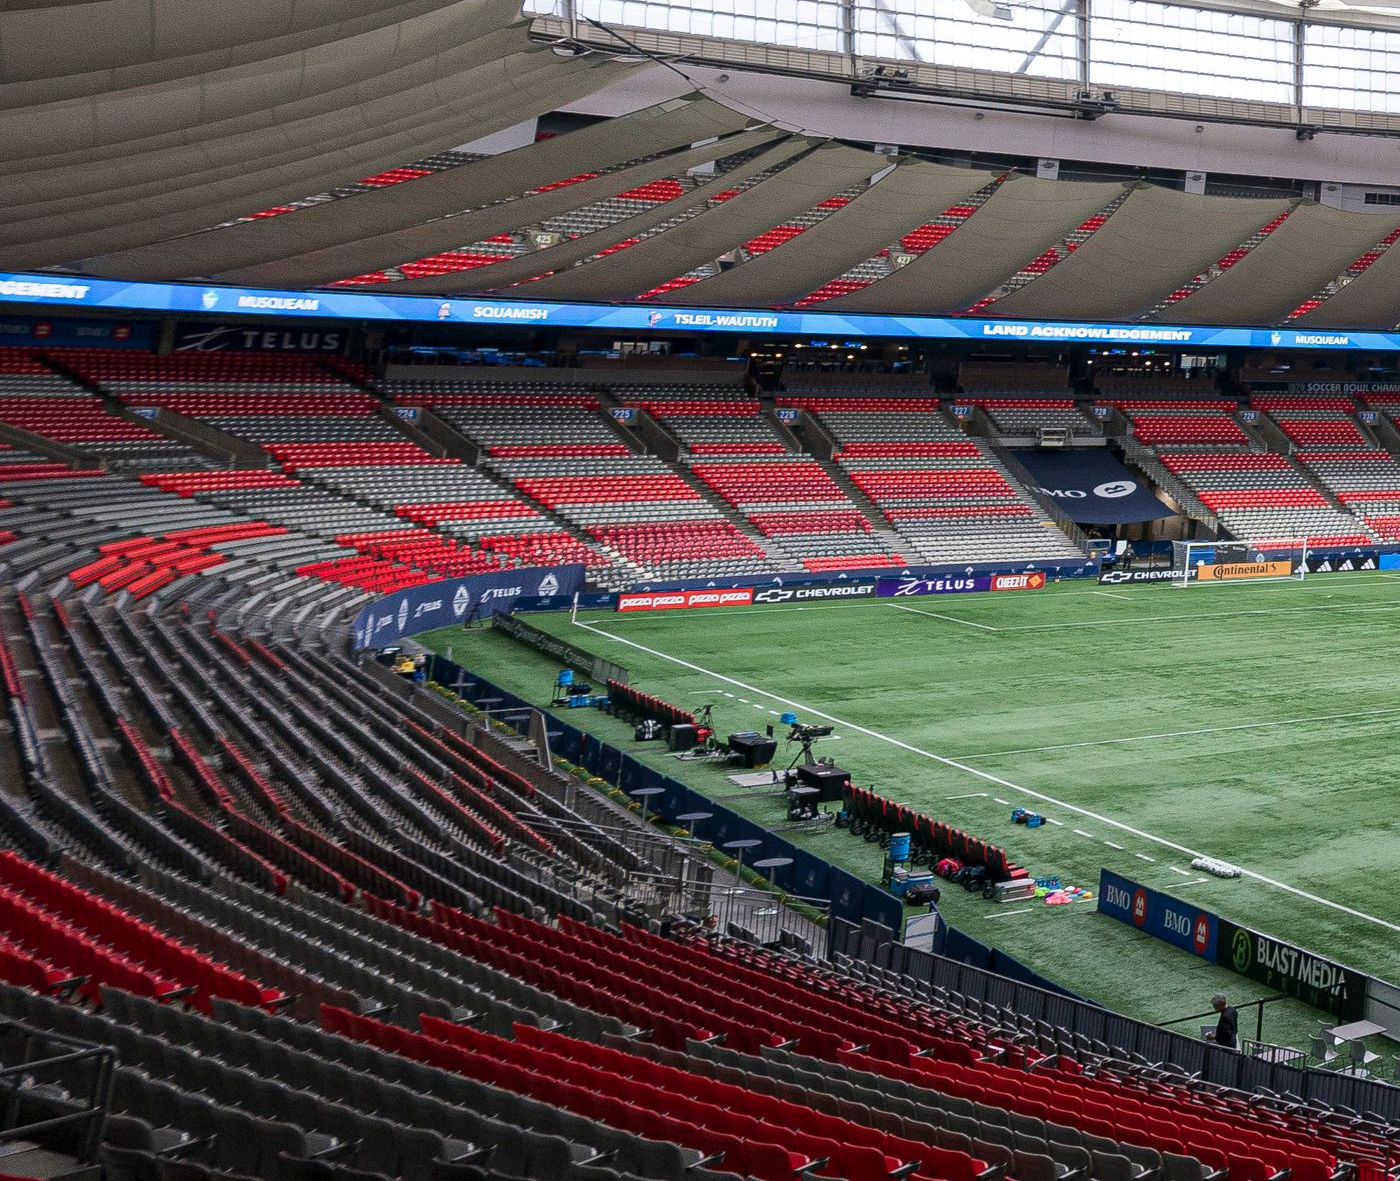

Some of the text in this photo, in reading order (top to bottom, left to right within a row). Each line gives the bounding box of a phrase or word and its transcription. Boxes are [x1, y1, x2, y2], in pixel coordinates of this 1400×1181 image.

[536, 234, 552, 244] 425
[238, 295, 320, 311] MUSQUEAM
[473, 306, 548, 320] SQUAMISH
[674, 313, 778, 328] TSLEIL-WAUTUTH
[242, 330, 341, 350] TELUS
[983, 324, 1192, 342] LAND ACKNOWLEDGEMENT
[1295, 335, 1349, 345] MUSQUEAM
[1307, 383, 1341, 392] SOCCER
[1343, 383, 1370, 392] BOWL
[613, 409, 631, 419] 225
[779, 410, 795, 420] 226
[953, 406, 968, 416] 227
[1134, 568, 1197, 580] CHEVROLET
[1213, 562, 1269, 579] Continental
[493, 585, 522, 598] TELUS
[795, 584, 874, 599] CHEVROLET
[925, 579, 975, 591] TELUS
[619, 592, 750, 610] pizza pizza pizza pizza
[1106, 884, 1131, 911] BMO
[1164, 909, 1191, 937] BMO
[1257, 937, 1348, 1000] BLAST MEDIA
